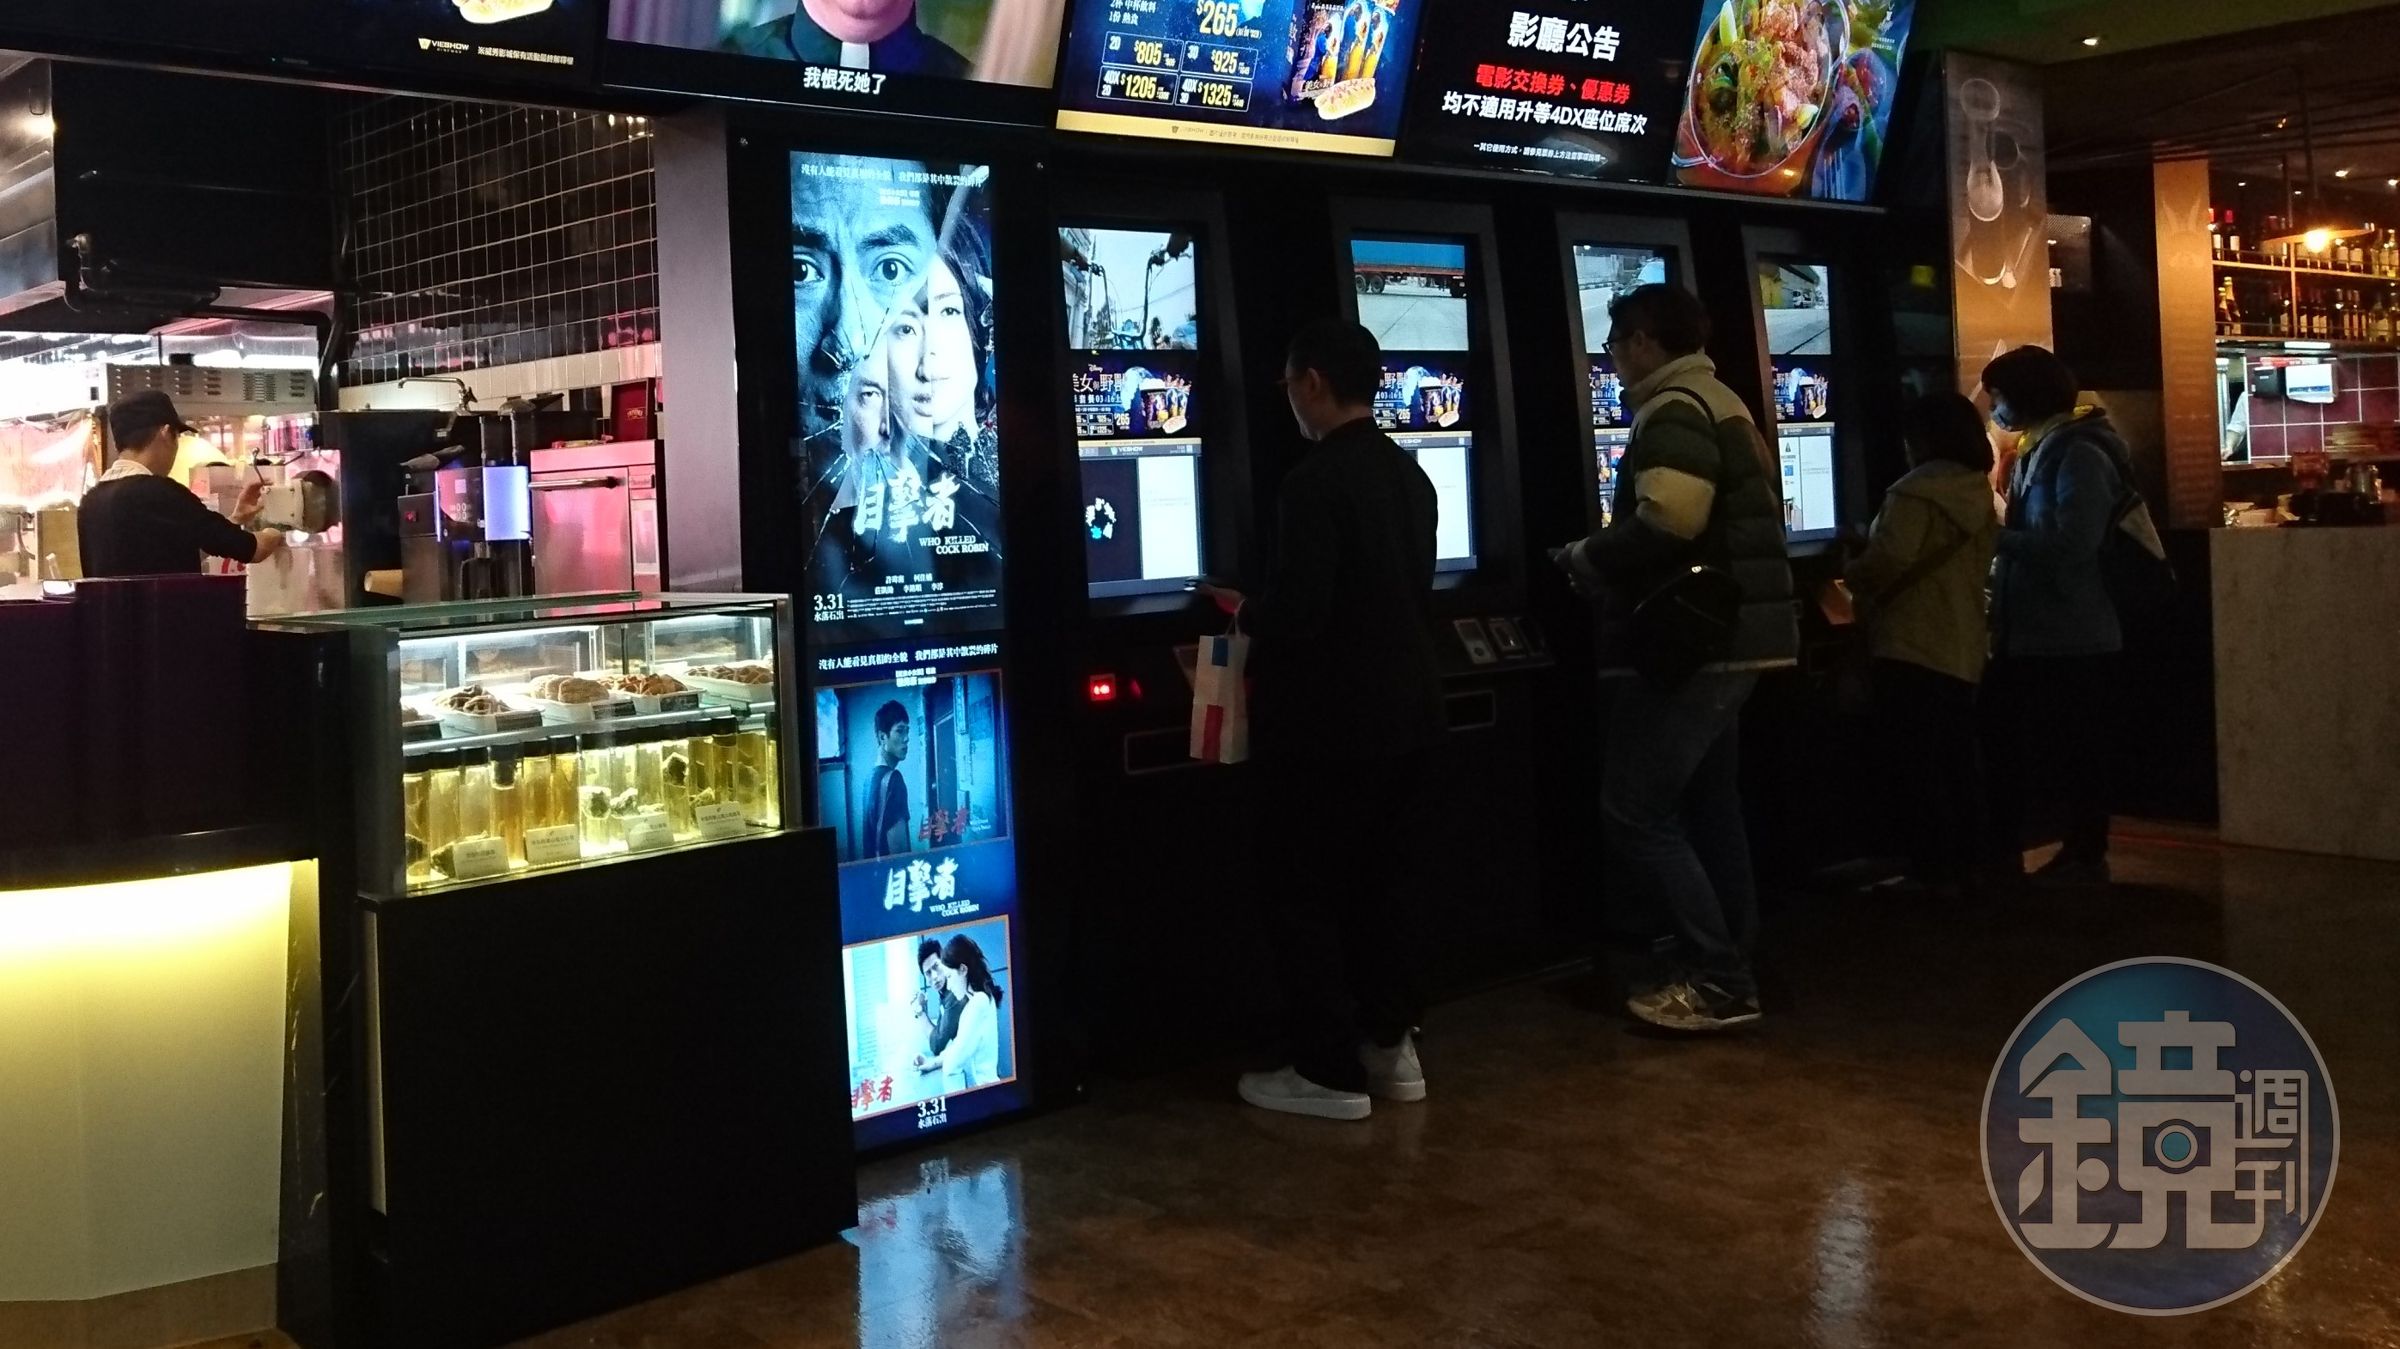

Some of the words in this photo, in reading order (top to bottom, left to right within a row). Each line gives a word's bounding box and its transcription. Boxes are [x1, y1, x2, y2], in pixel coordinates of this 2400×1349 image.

[1196, 0, 1239, 38] $265
[431, 40, 469, 51] VIESHOW
[1507, 11, 1620, 62] 影廳公告
[1134, 40, 1163, 66] $805
[1211, 49, 1239, 75] $925
[803, 66, 886, 95] 我恨死她了
[1120, 73, 1158, 99] $1205
[1197, 79, 1233, 107] $1325
[1475, 63, 1632, 105] 電影交換券、優惠券
[1441, 90, 1648, 136] 均不適用升等4DX座位席次
[853, 468, 961, 543] 目擊者
[919, 537, 941, 546] WHO
[944, 535, 976, 545] KILLED
[936, 545, 960, 554] COCK
[961, 542, 989, 553] ROBIN
[814, 593, 844, 611] 3.31
[814, 610, 845, 622] 水落石出
[818, 652, 909, 671] 沒有人能看見真相的全貌
[884, 857, 959, 913] 目擊者
[930, 904, 945, 912] WHO
[917, 1096, 947, 1118] 3.31
